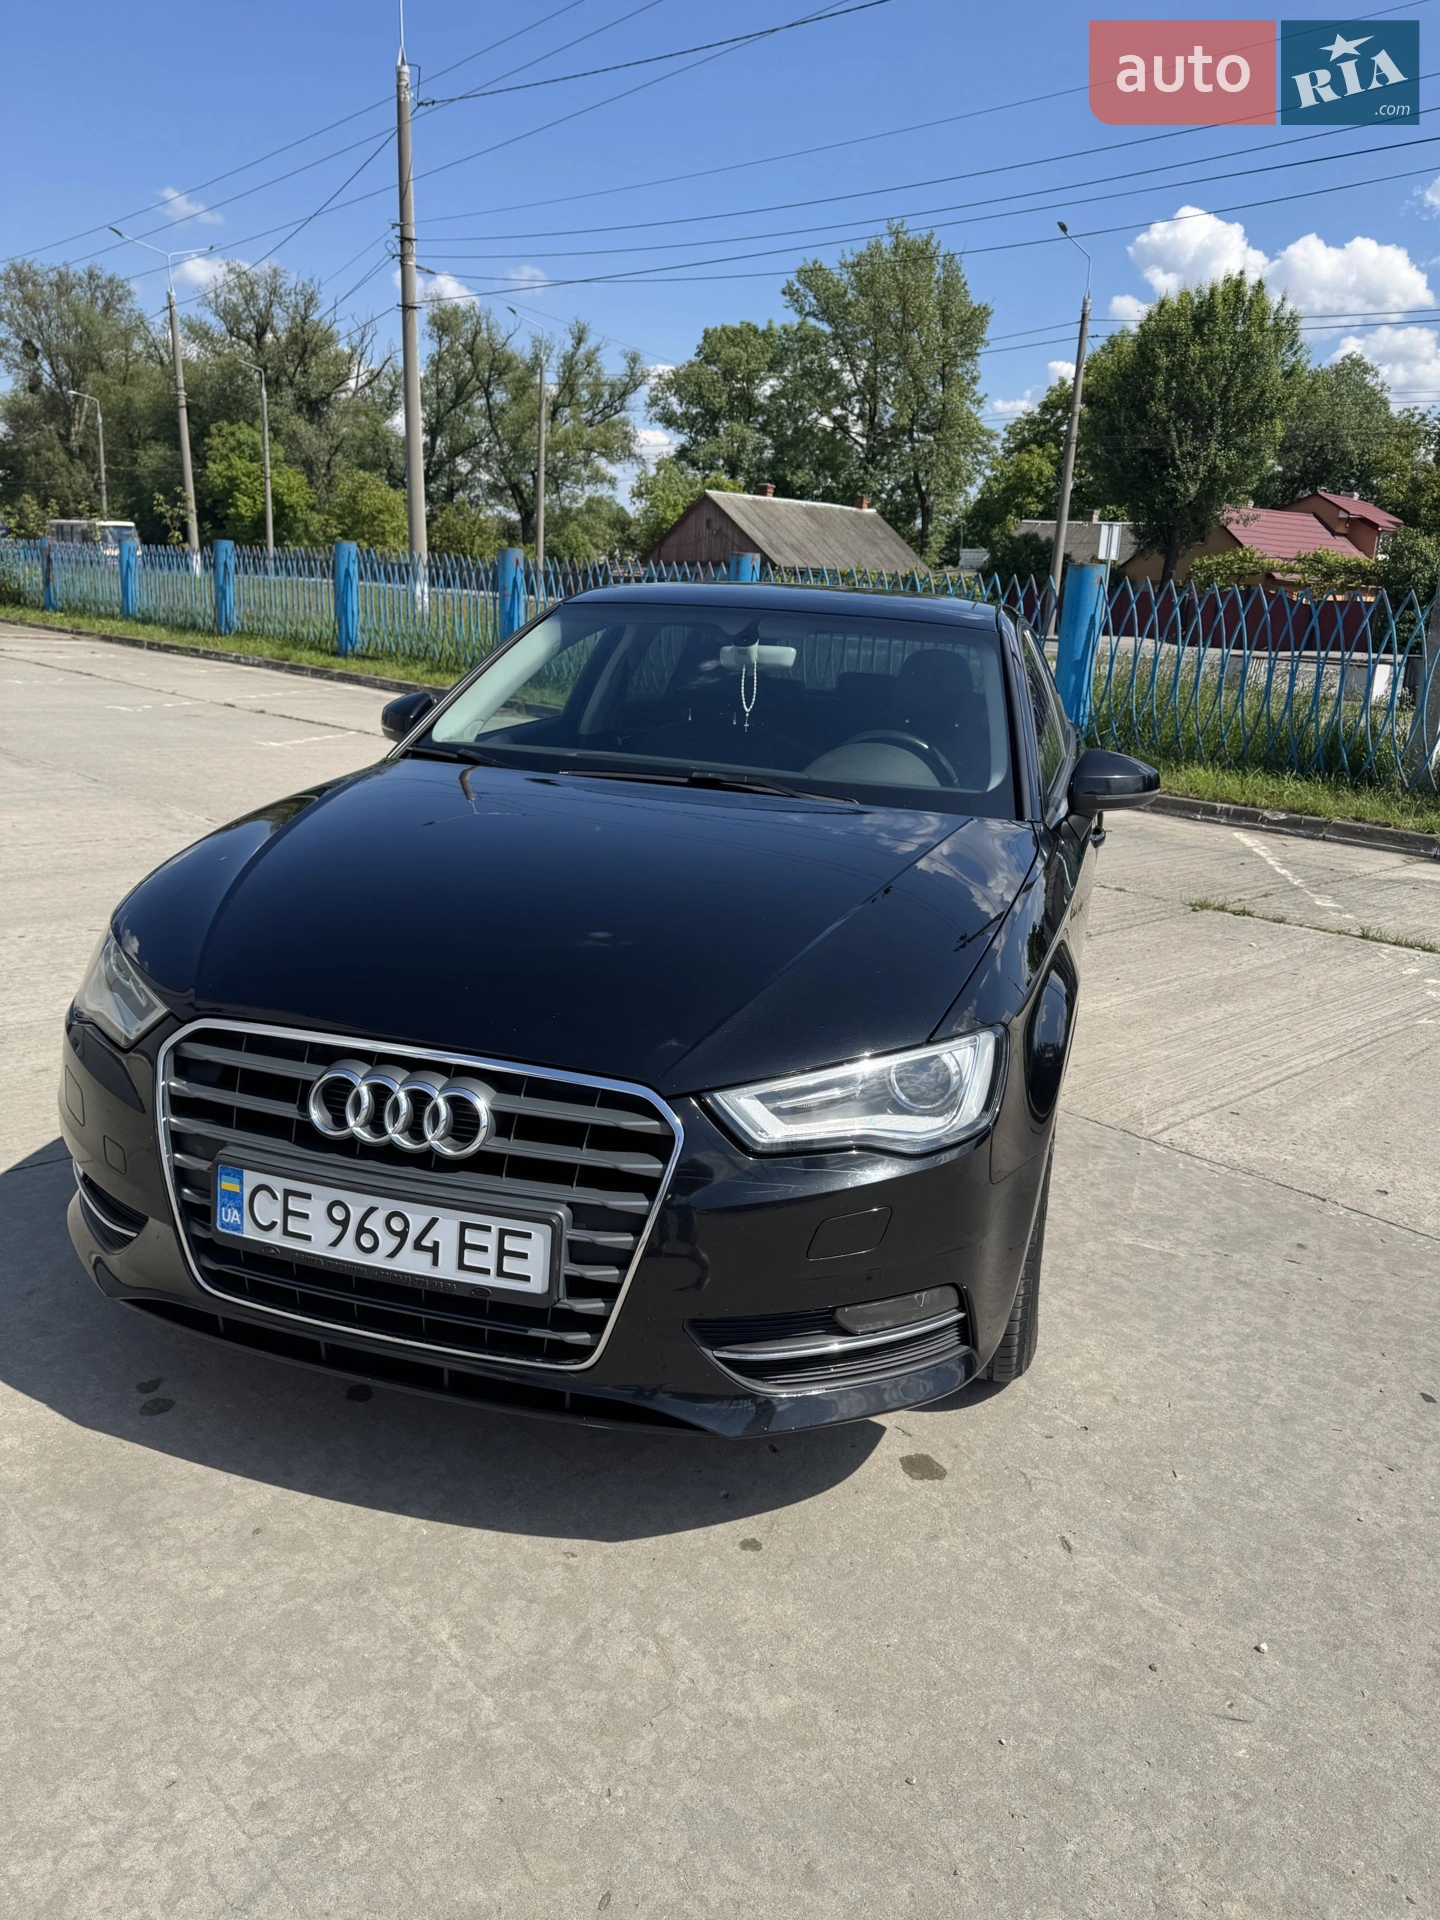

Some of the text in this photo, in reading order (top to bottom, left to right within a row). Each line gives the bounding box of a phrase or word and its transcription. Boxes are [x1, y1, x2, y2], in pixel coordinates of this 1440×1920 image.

[221, 1206, 241, 1225] UA
[248, 1183, 533, 1283] CE 9694 EE
